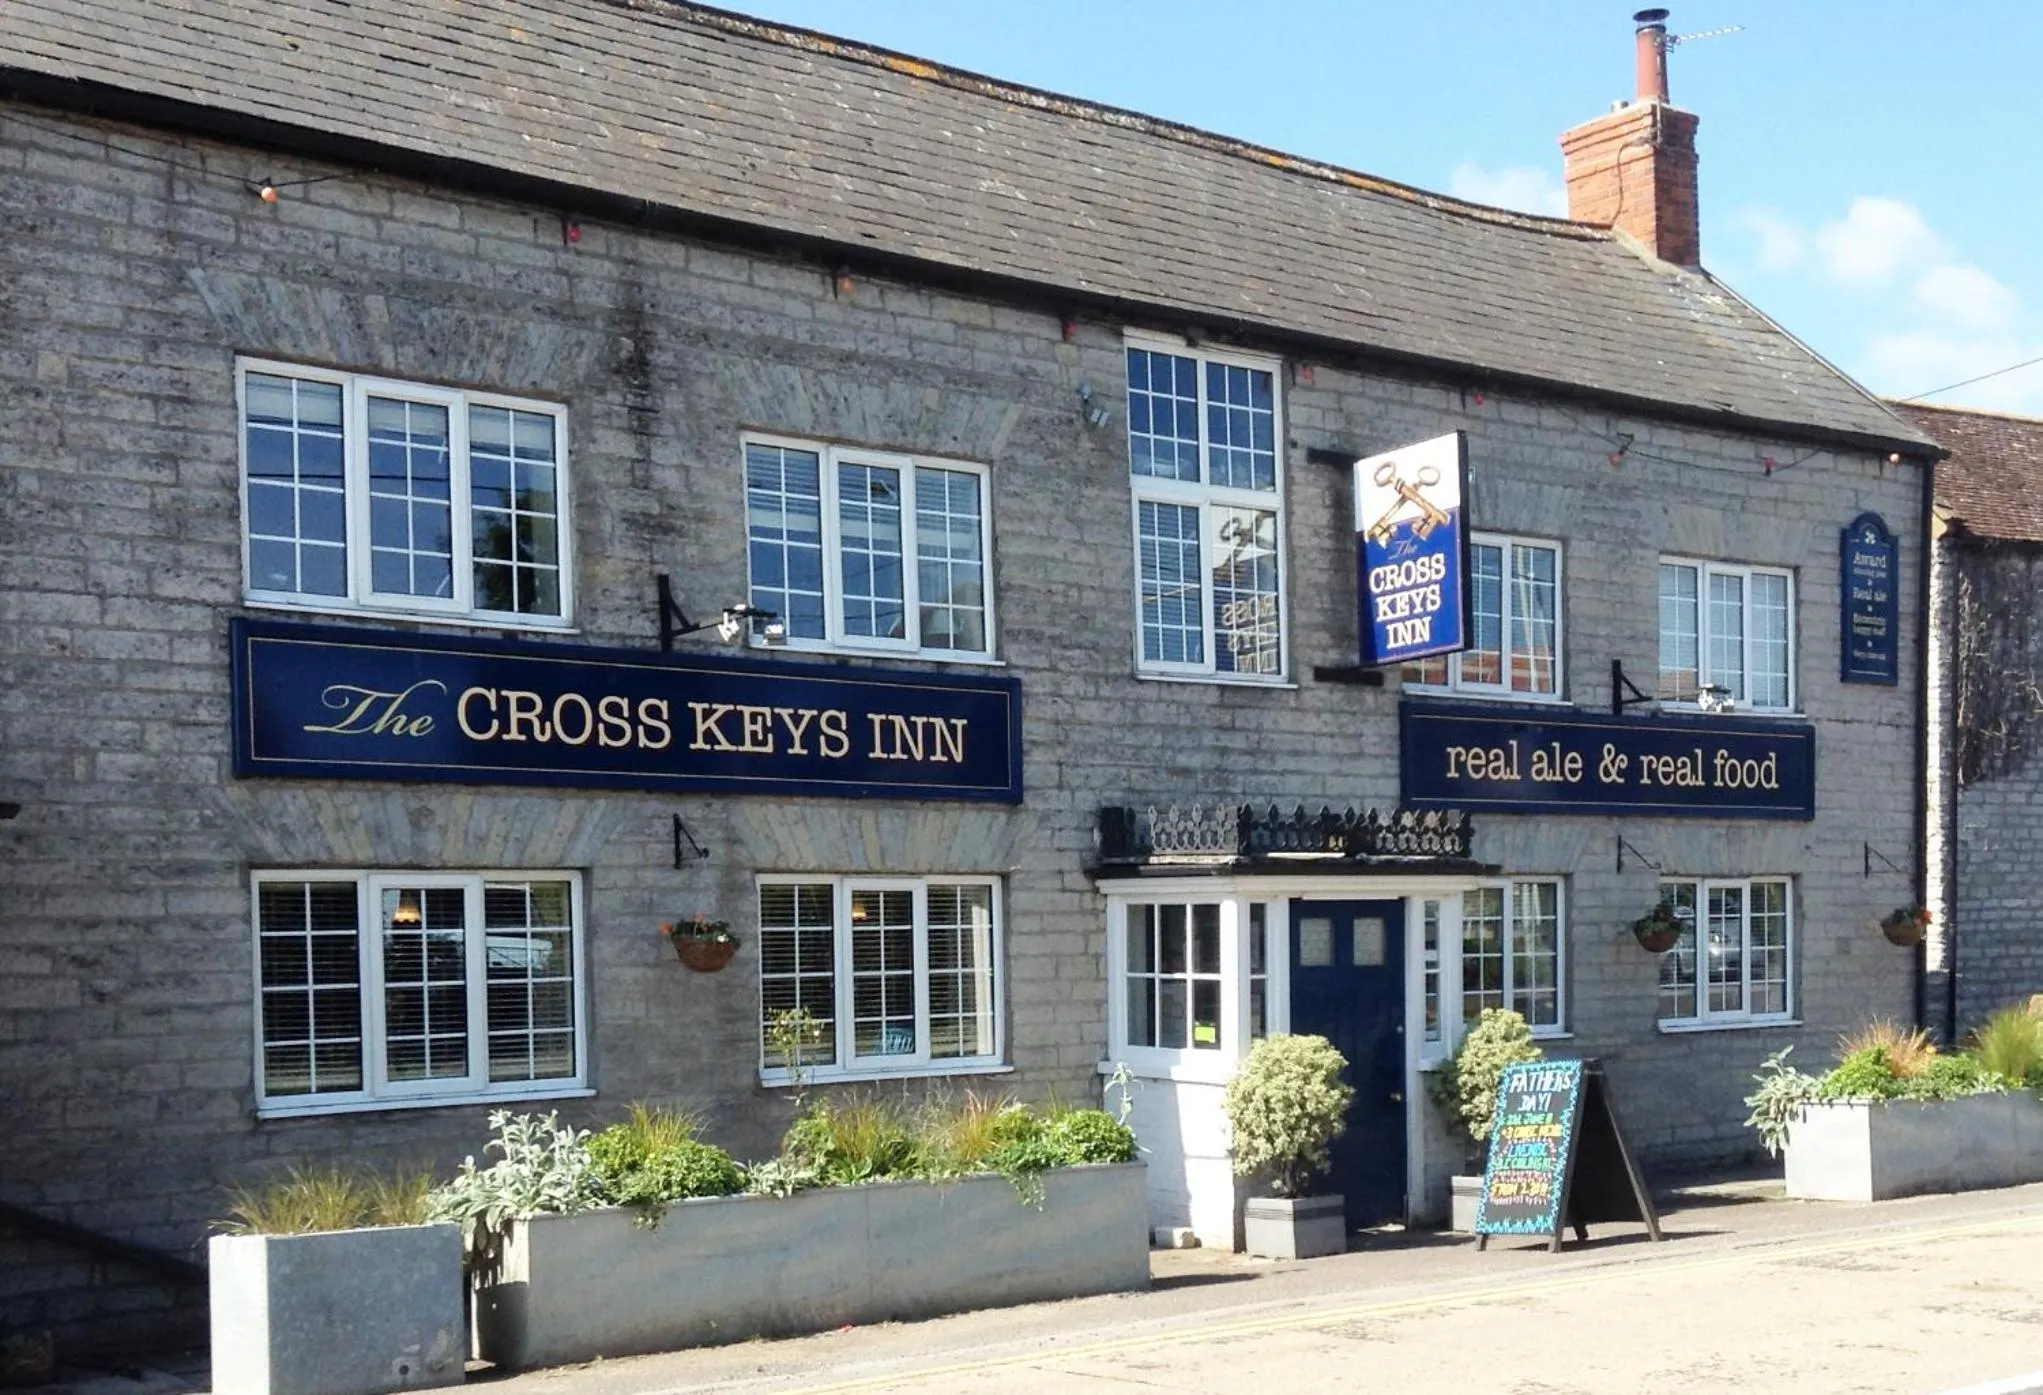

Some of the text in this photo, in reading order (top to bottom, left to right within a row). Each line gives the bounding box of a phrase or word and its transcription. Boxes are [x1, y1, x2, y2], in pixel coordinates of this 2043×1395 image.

[1369, 553, 1446, 593] CROSS
[1376, 584, 1441, 621] KEYS
[1386, 616, 1431, 649] INN
[303, 679, 968, 763] The CROSS KEYS INN
[1446, 740, 1779, 789] real ale & real food
